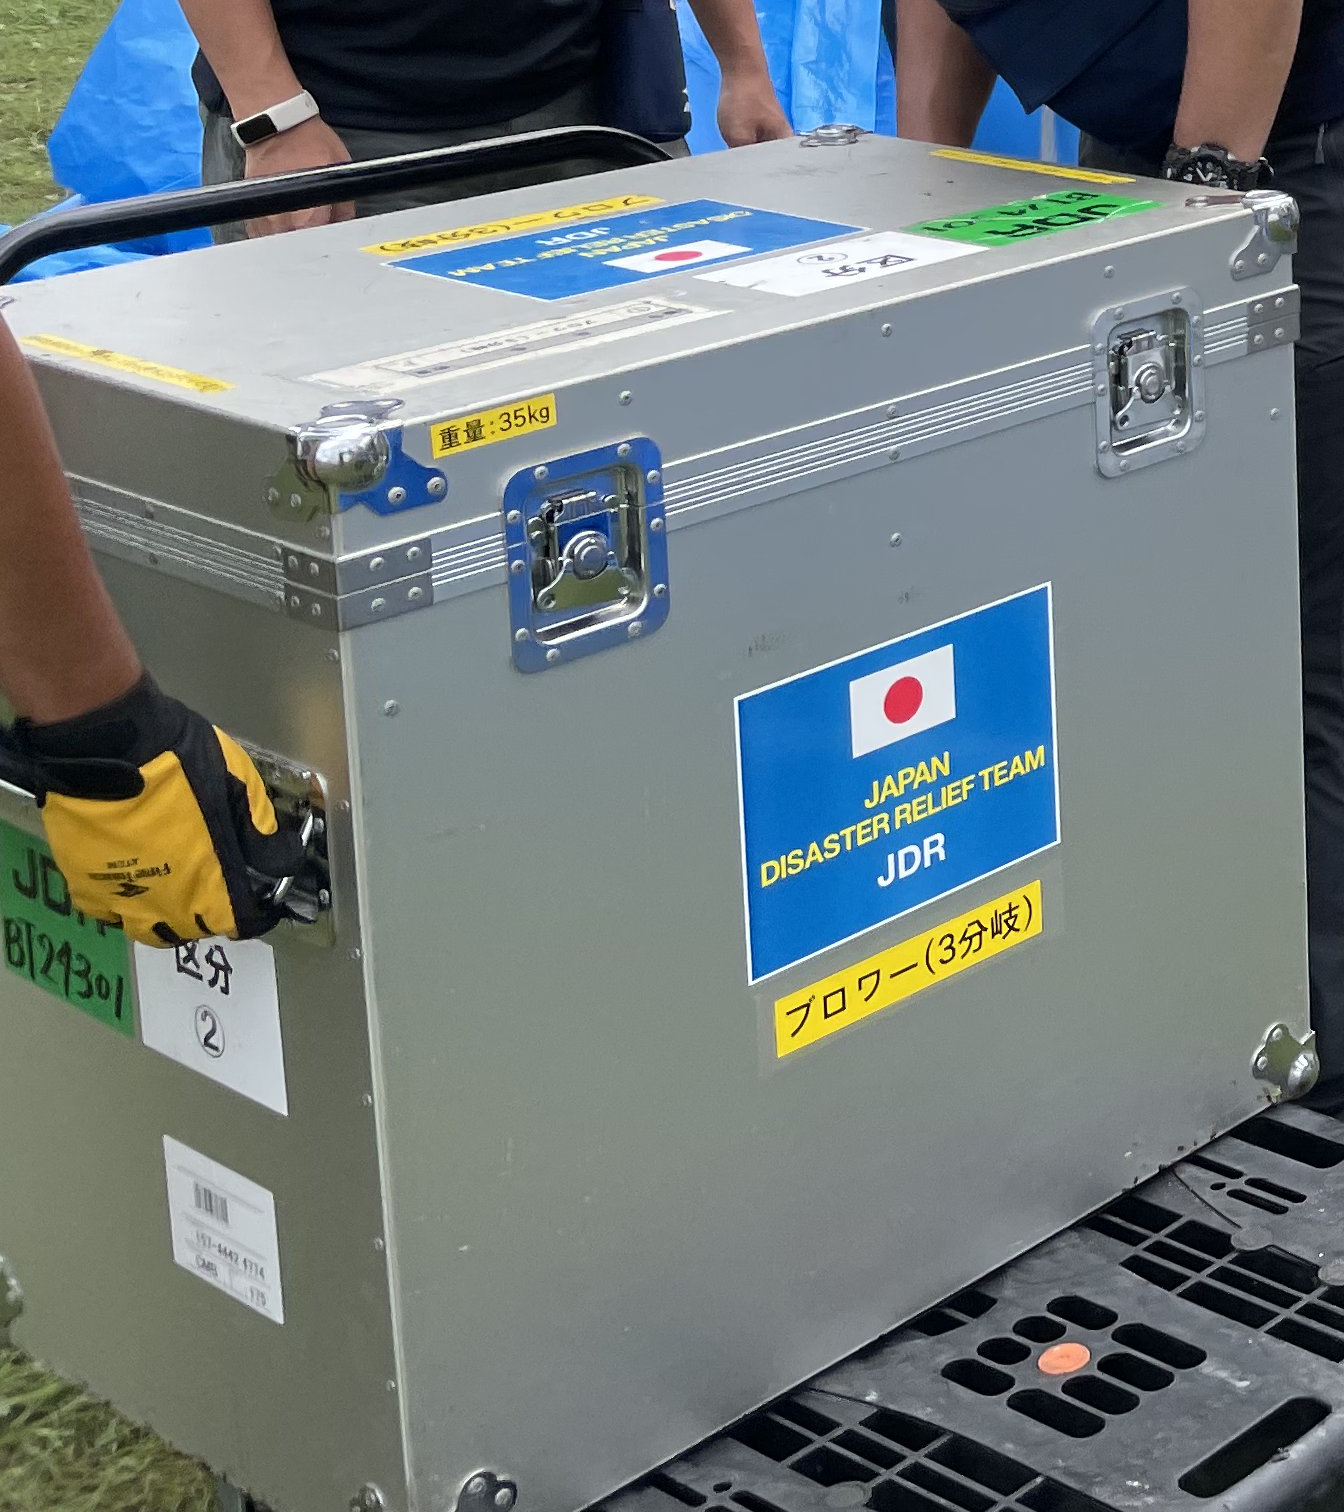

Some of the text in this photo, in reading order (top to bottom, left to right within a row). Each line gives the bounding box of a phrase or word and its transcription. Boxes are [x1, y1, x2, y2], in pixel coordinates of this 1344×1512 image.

[536, 226, 611, 246] JDR
[985, 203, 1118, 238] JDR
[864, 750, 950, 809] JAPAN
[760, 744, 1046, 889] DISASTER RELIEF TEAM
[877, 832, 946, 888] JDR
[12, 848, 124, 936] JD
[785, 894, 1033, 1038] ブロワー(3分岐)
